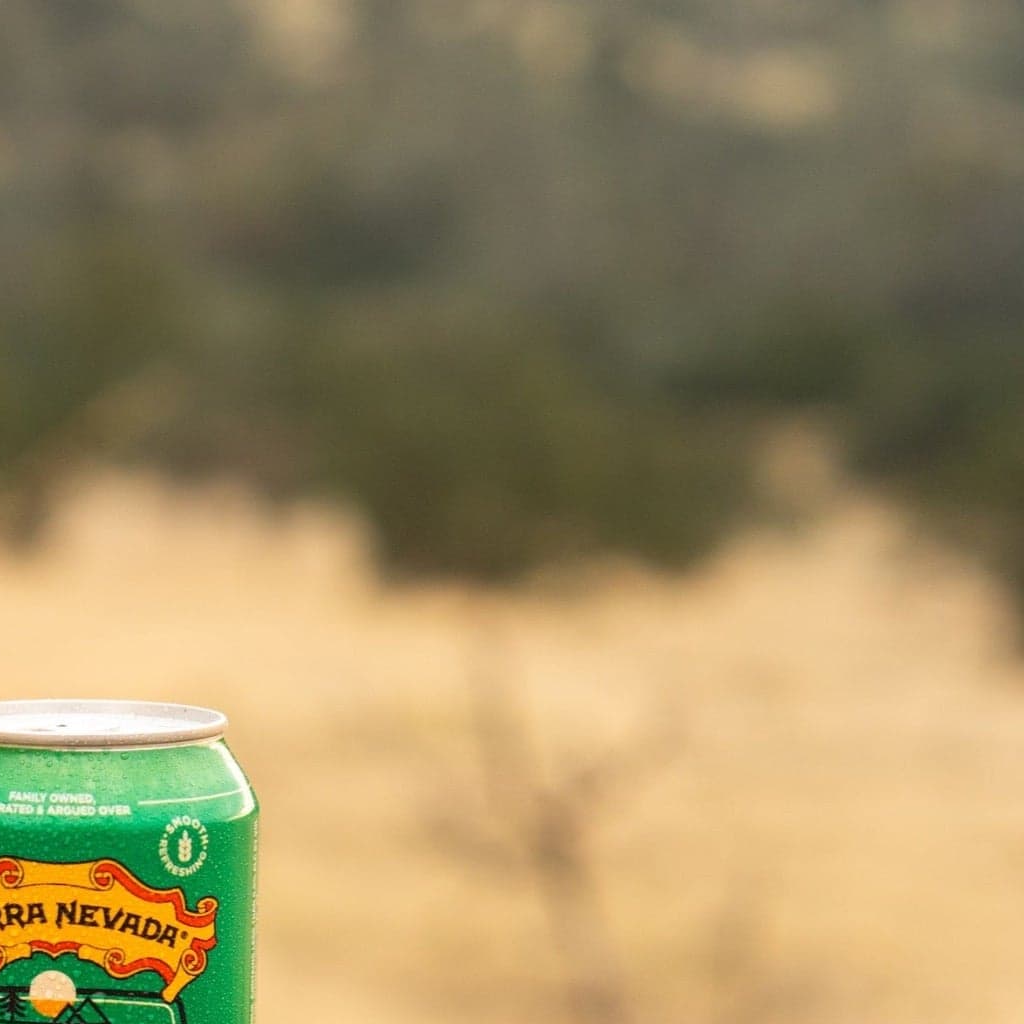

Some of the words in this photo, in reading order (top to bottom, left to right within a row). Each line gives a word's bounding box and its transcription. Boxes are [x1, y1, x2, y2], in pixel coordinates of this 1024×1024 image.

[8, 791, 47, 803] FAMILY
[46, 805, 96, 816] ARGUED
[98, 805, 132, 816] OVER
[165, 815, 208, 846] SMOOTH
[158, 839, 207, 877] REFRESHING
